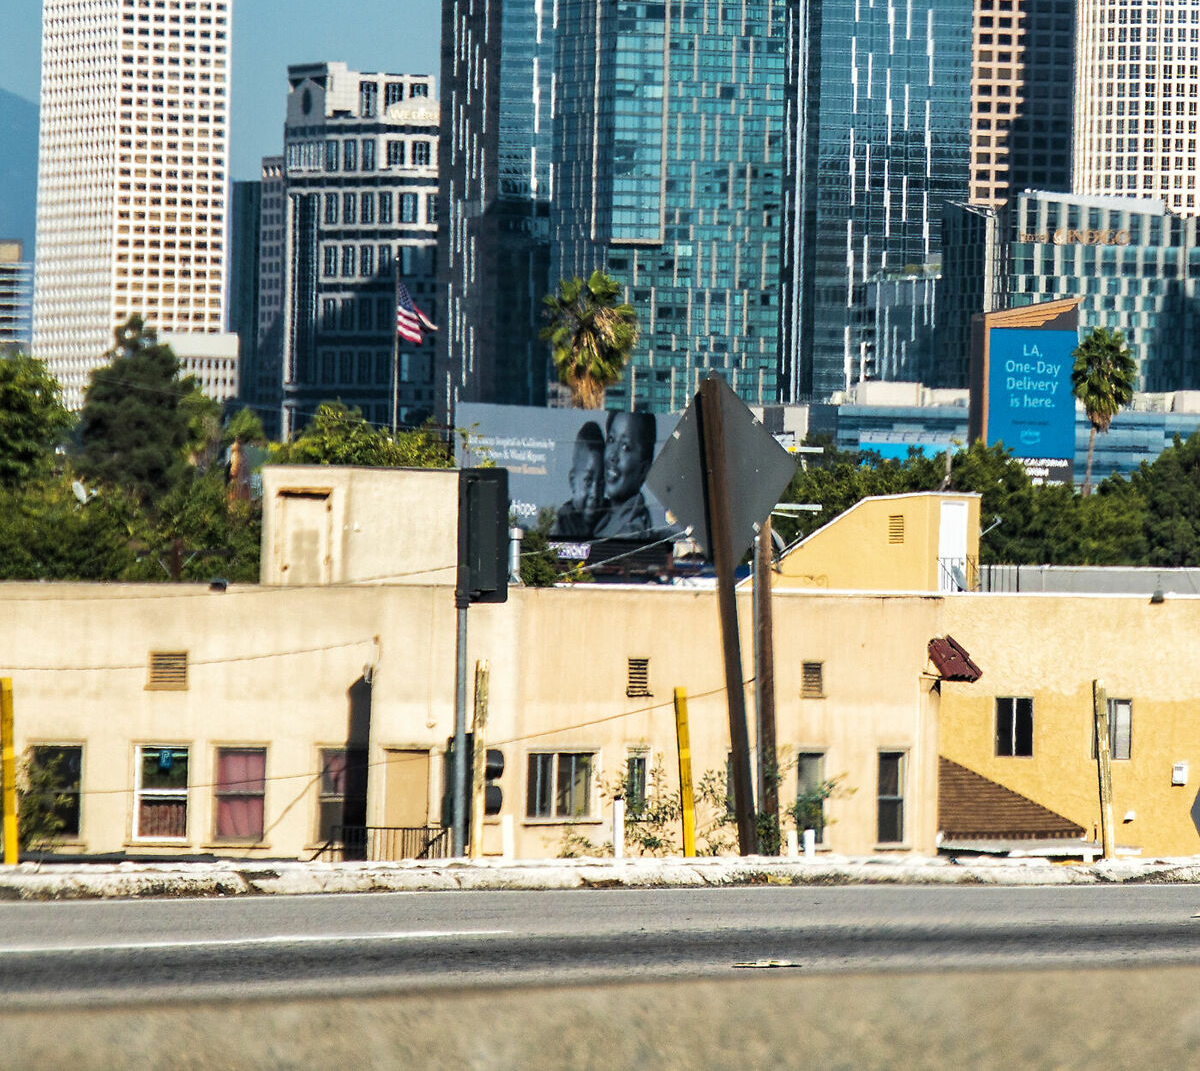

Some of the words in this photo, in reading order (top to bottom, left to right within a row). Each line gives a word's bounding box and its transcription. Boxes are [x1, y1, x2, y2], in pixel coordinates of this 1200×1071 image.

[1022, 344, 1043, 358] LA,
[1005, 360, 1061, 377] One-Day
[1006, 377, 1059, 394] Delivery
[1010, 394, 1019, 407] is
[1023, 394, 1055, 408] here.
